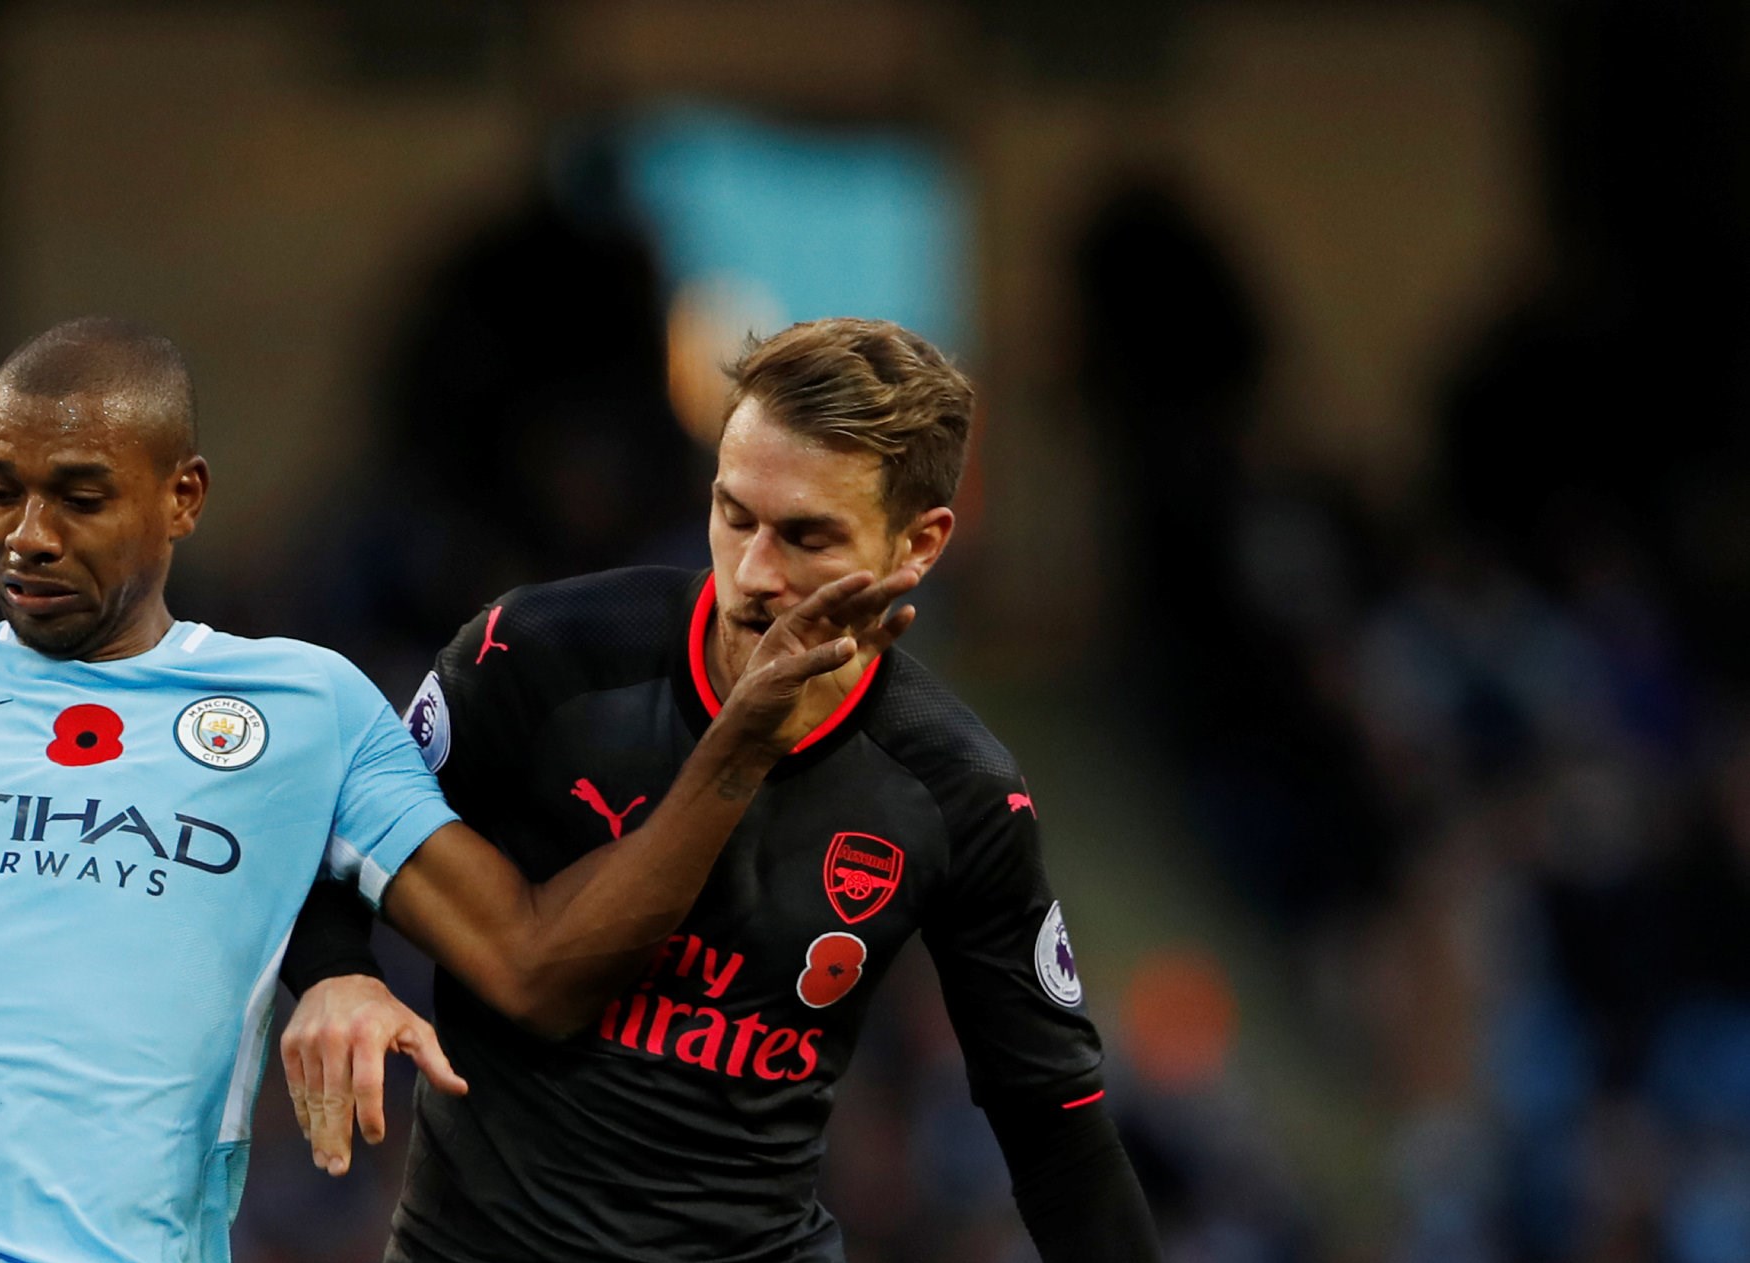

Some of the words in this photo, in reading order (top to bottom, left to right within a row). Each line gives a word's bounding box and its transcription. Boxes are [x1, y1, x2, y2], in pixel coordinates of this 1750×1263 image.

[188, 700, 260, 728] MANCHESTER
[202, 752, 230, 764] CITY
[600, 981, 825, 1081] irates
